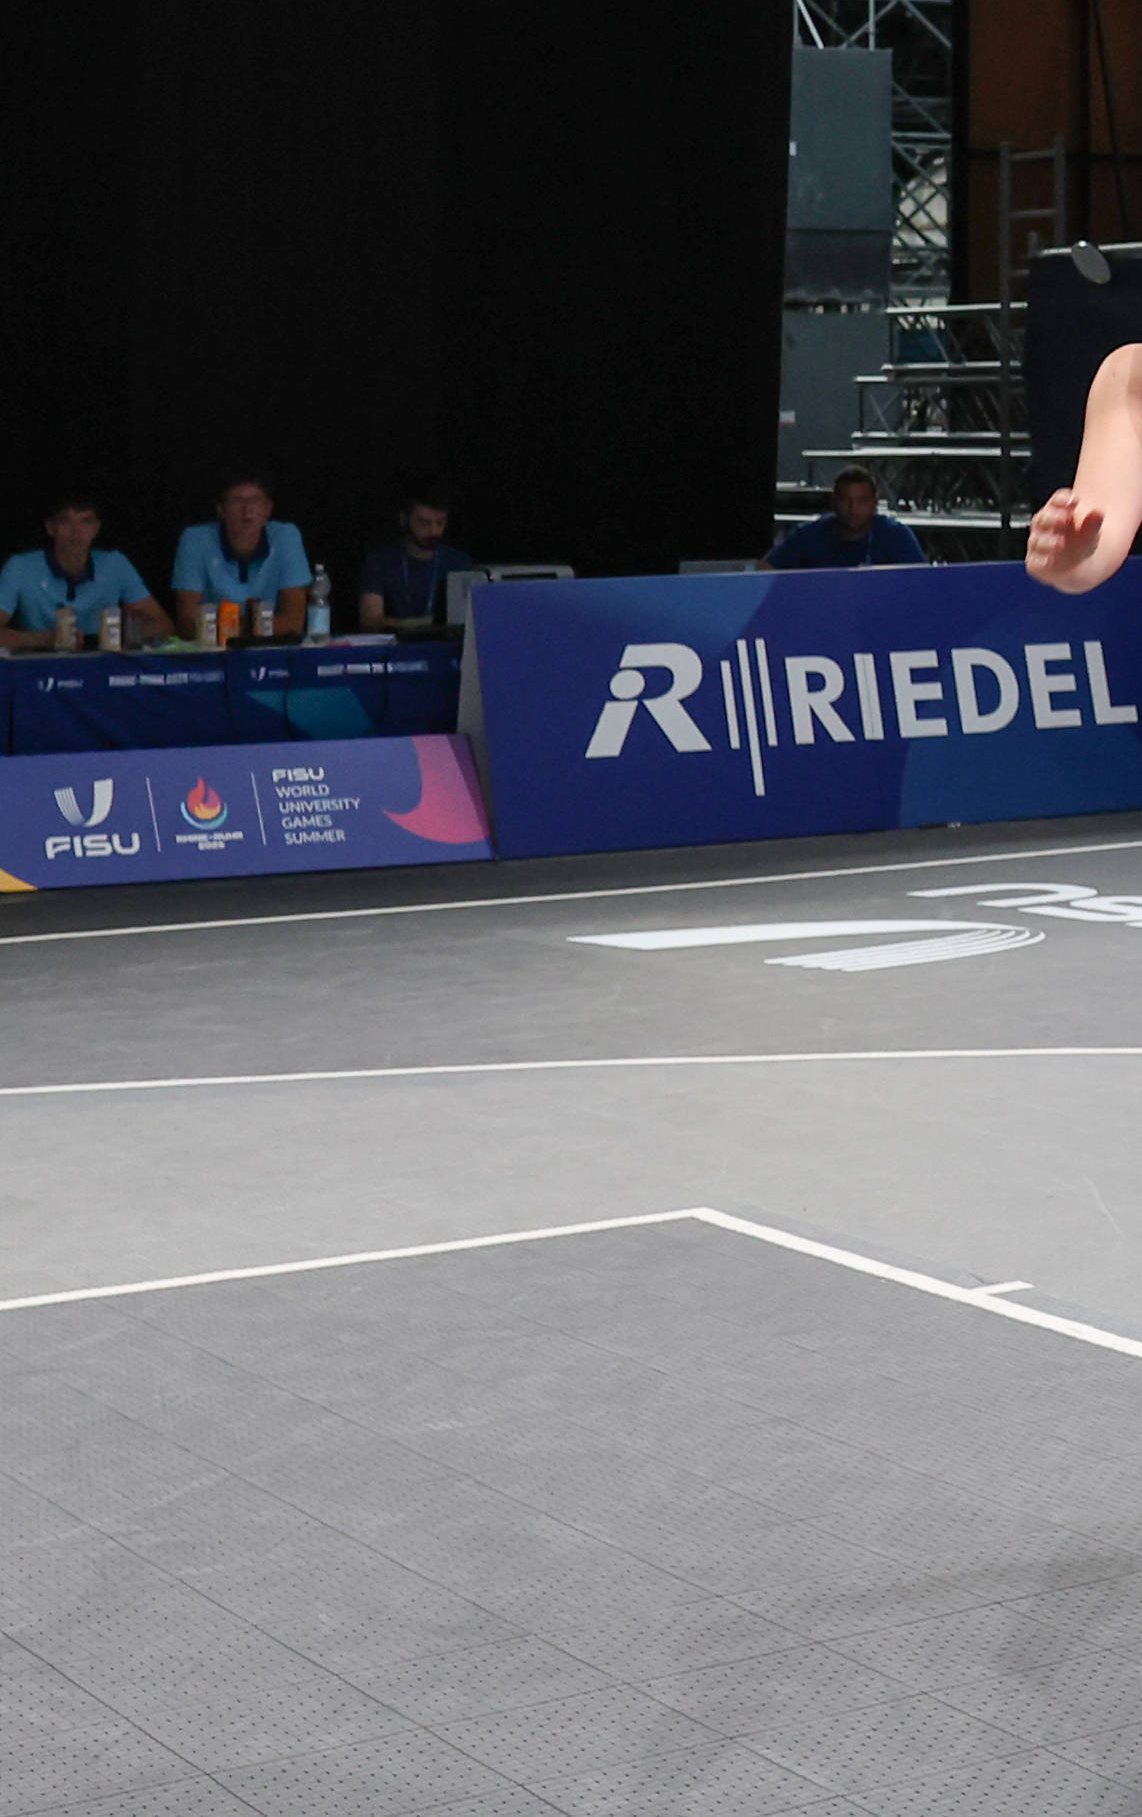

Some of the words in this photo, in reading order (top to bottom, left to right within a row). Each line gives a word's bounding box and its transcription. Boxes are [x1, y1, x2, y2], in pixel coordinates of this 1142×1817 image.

[785, 640, 1139, 745] RIEDEL
[272, 767, 324, 783] FISU
[275, 784, 330, 798] WORLD
[279, 797, 360, 814] UNIVERSITY
[281, 814, 333, 830] GAMES
[45, 832, 141, 860] FISU
[284, 829, 346, 846] SUMMER
